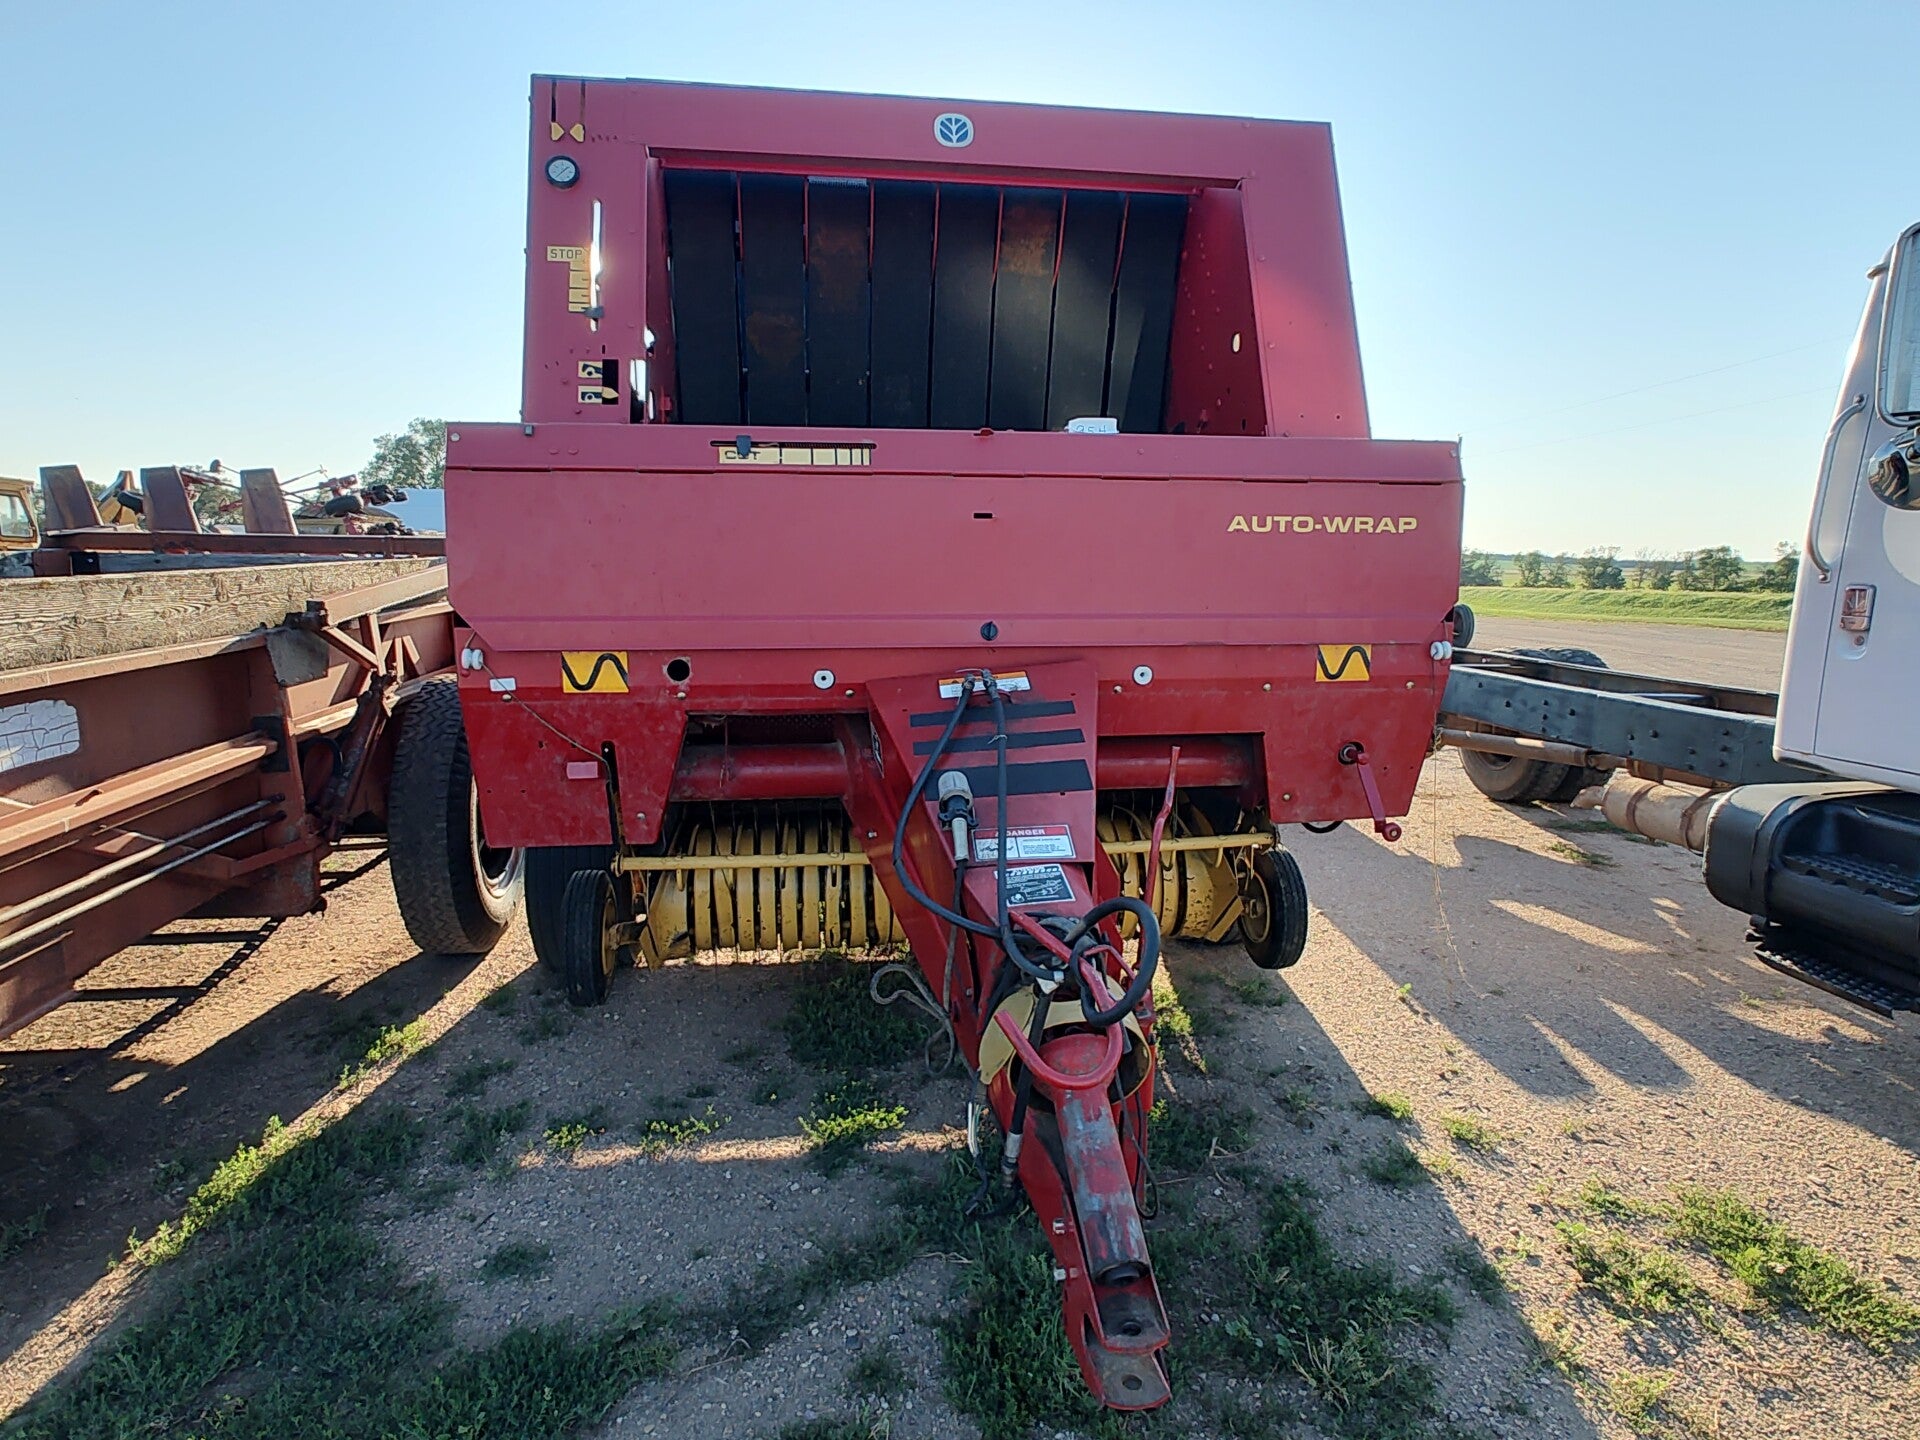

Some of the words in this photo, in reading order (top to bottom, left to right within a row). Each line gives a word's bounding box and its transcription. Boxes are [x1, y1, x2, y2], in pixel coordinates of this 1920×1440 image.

[550, 248, 583, 259] STOP
[724, 450, 761, 460] CT
[1227, 515, 1418, 534] AUTO-WRAP
